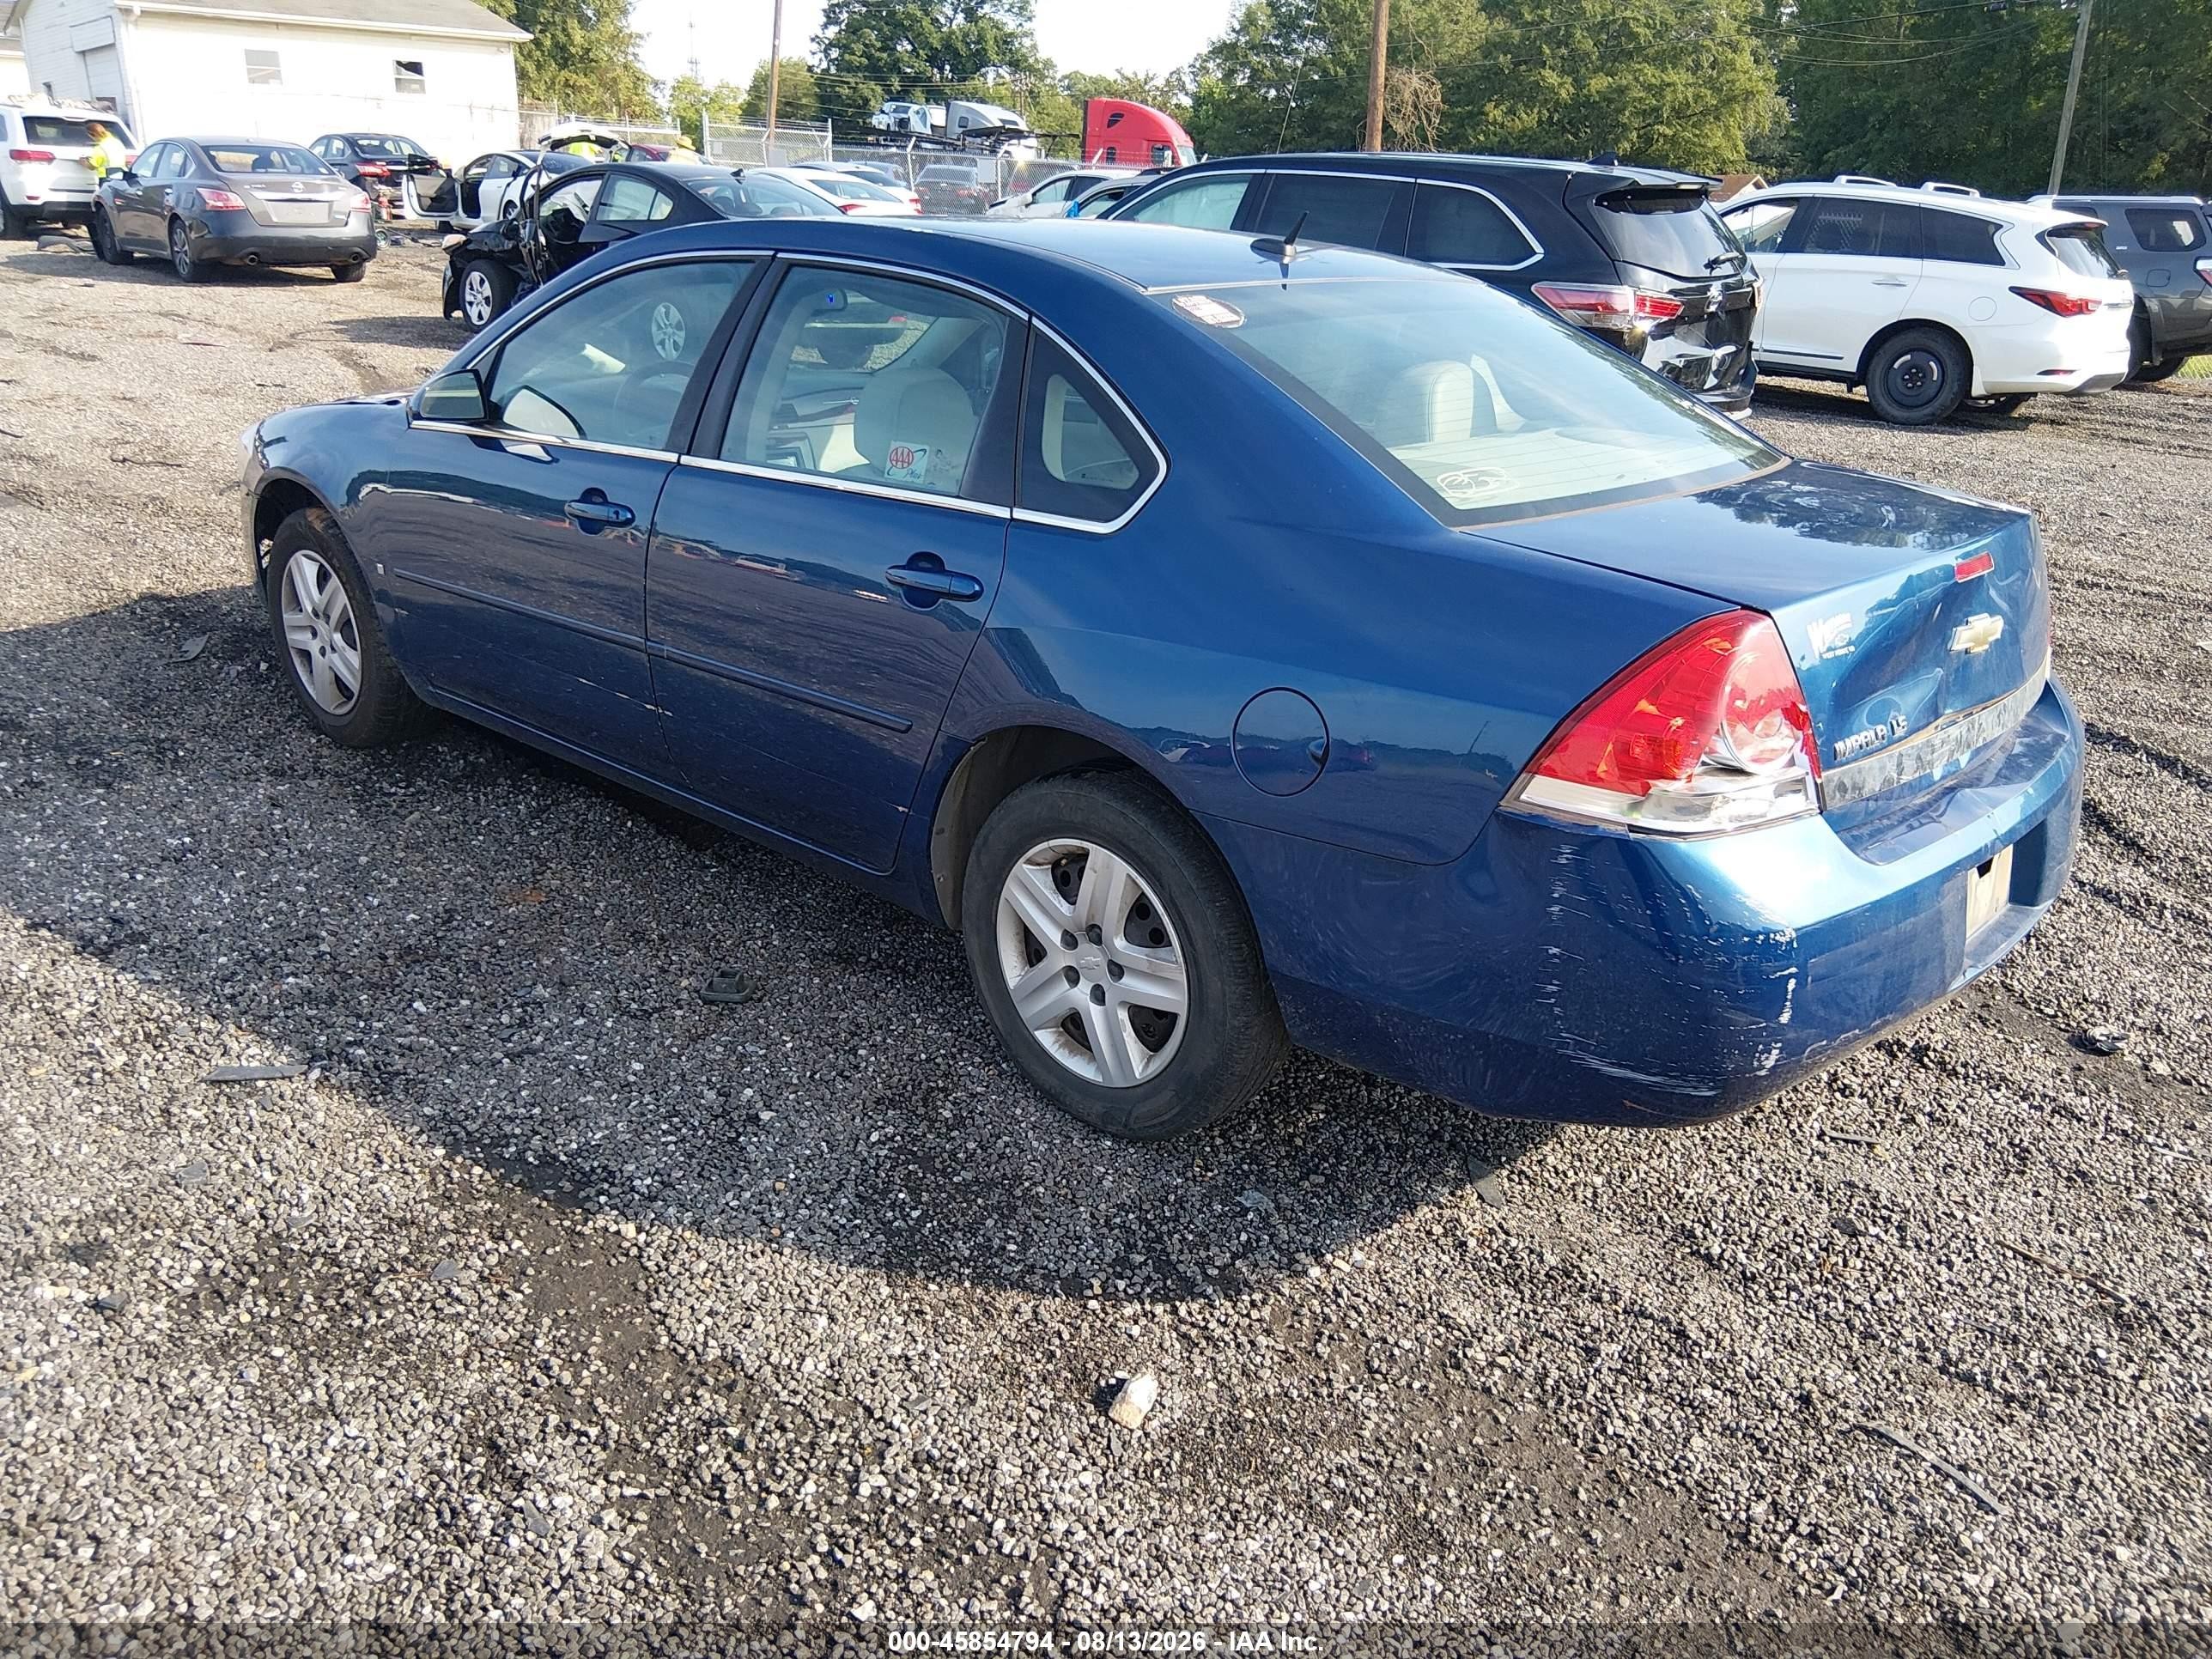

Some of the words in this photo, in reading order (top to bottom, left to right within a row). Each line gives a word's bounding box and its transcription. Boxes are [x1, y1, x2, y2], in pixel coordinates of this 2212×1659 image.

[890, 447, 914, 469] AAA
[1833, 724, 1887, 761] IMPALA
[1889, 714, 1908, 736] LS
